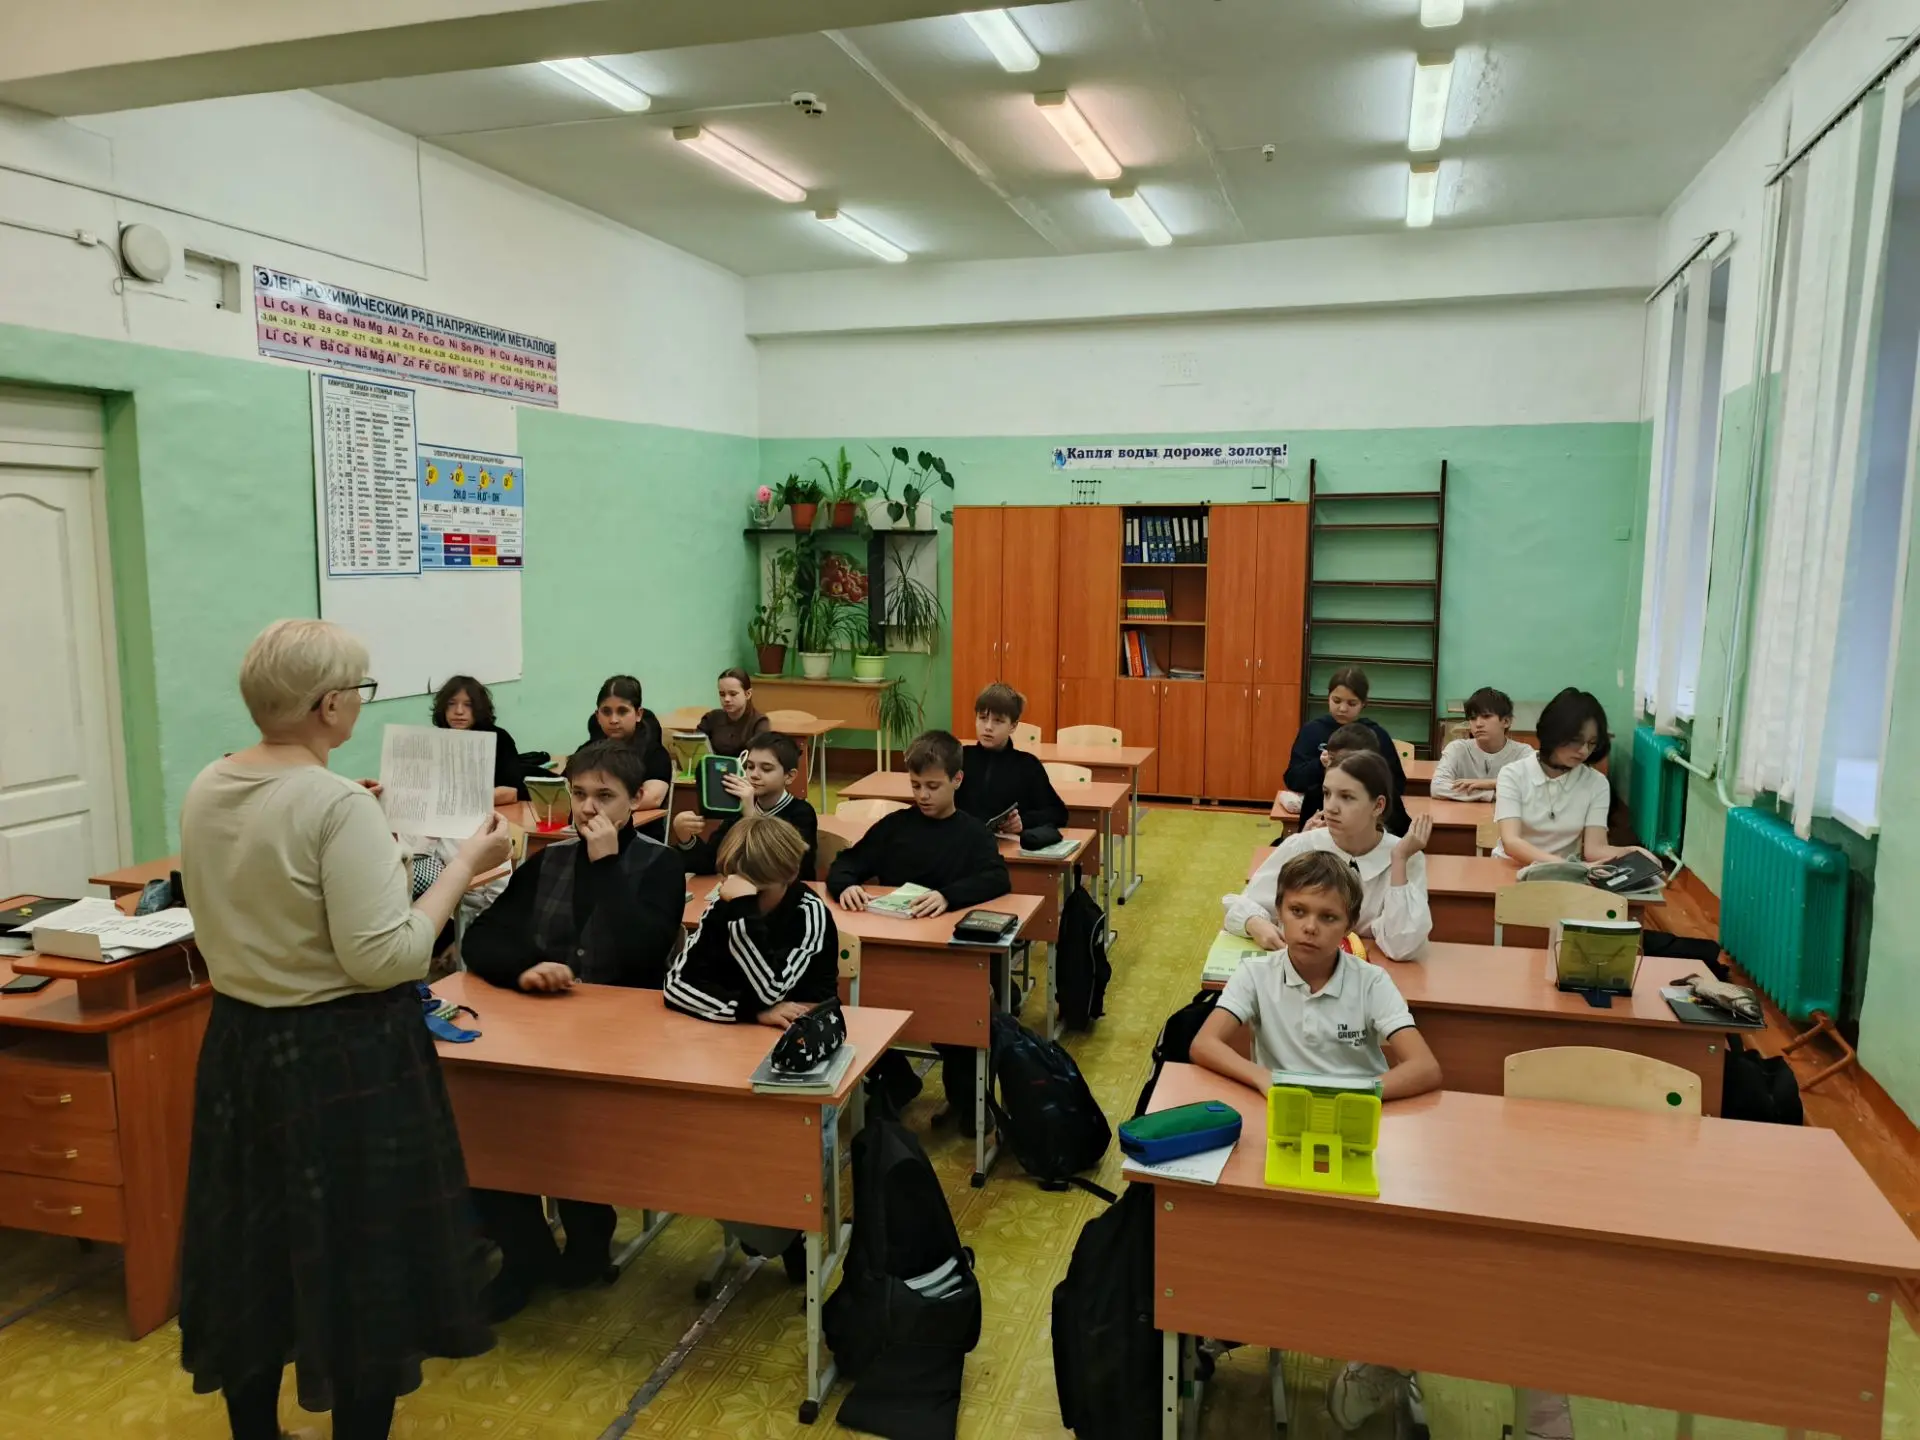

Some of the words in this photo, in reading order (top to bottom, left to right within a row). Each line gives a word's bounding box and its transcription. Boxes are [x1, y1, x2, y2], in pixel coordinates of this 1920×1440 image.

[259, 271, 408, 320] ЭЛЕРОХИМИЧЕСКИЙ
[411, 309, 434, 328] РЯД
[436, 315, 506, 342] НАПРЯЖЕНИЙ
[508, 333, 556, 355] МЕТАЛЛОВ
[263, 296, 275, 308] Li
[280, 300, 295, 313] Cs
[301, 305, 309, 316] K
[318, 308, 332, 321] Ba
[335, 313, 348, 324] Ca
[353, 317, 366, 329] Na
[368, 321, 383, 335] Mg
[387, 326, 397, 335] Al
[402, 328, 414, 339] Zn
[418, 332, 429, 343] Fe
[433, 336, 445, 346] Co
[449, 339, 458, 348] Ni
[460, 342, 472, 353] Sn
[473, 345, 484, 355] Pb
[500, 351, 510, 360] Cu
[513, 354, 524, 365] Ag
[537, 359, 545, 369] Pt
[1067, 446, 1113, 459] Капля
[1118, 446, 1158, 460] воды
[1163, 445, 1222, 461] дороже
[1227, 443, 1288, 457] золота!
